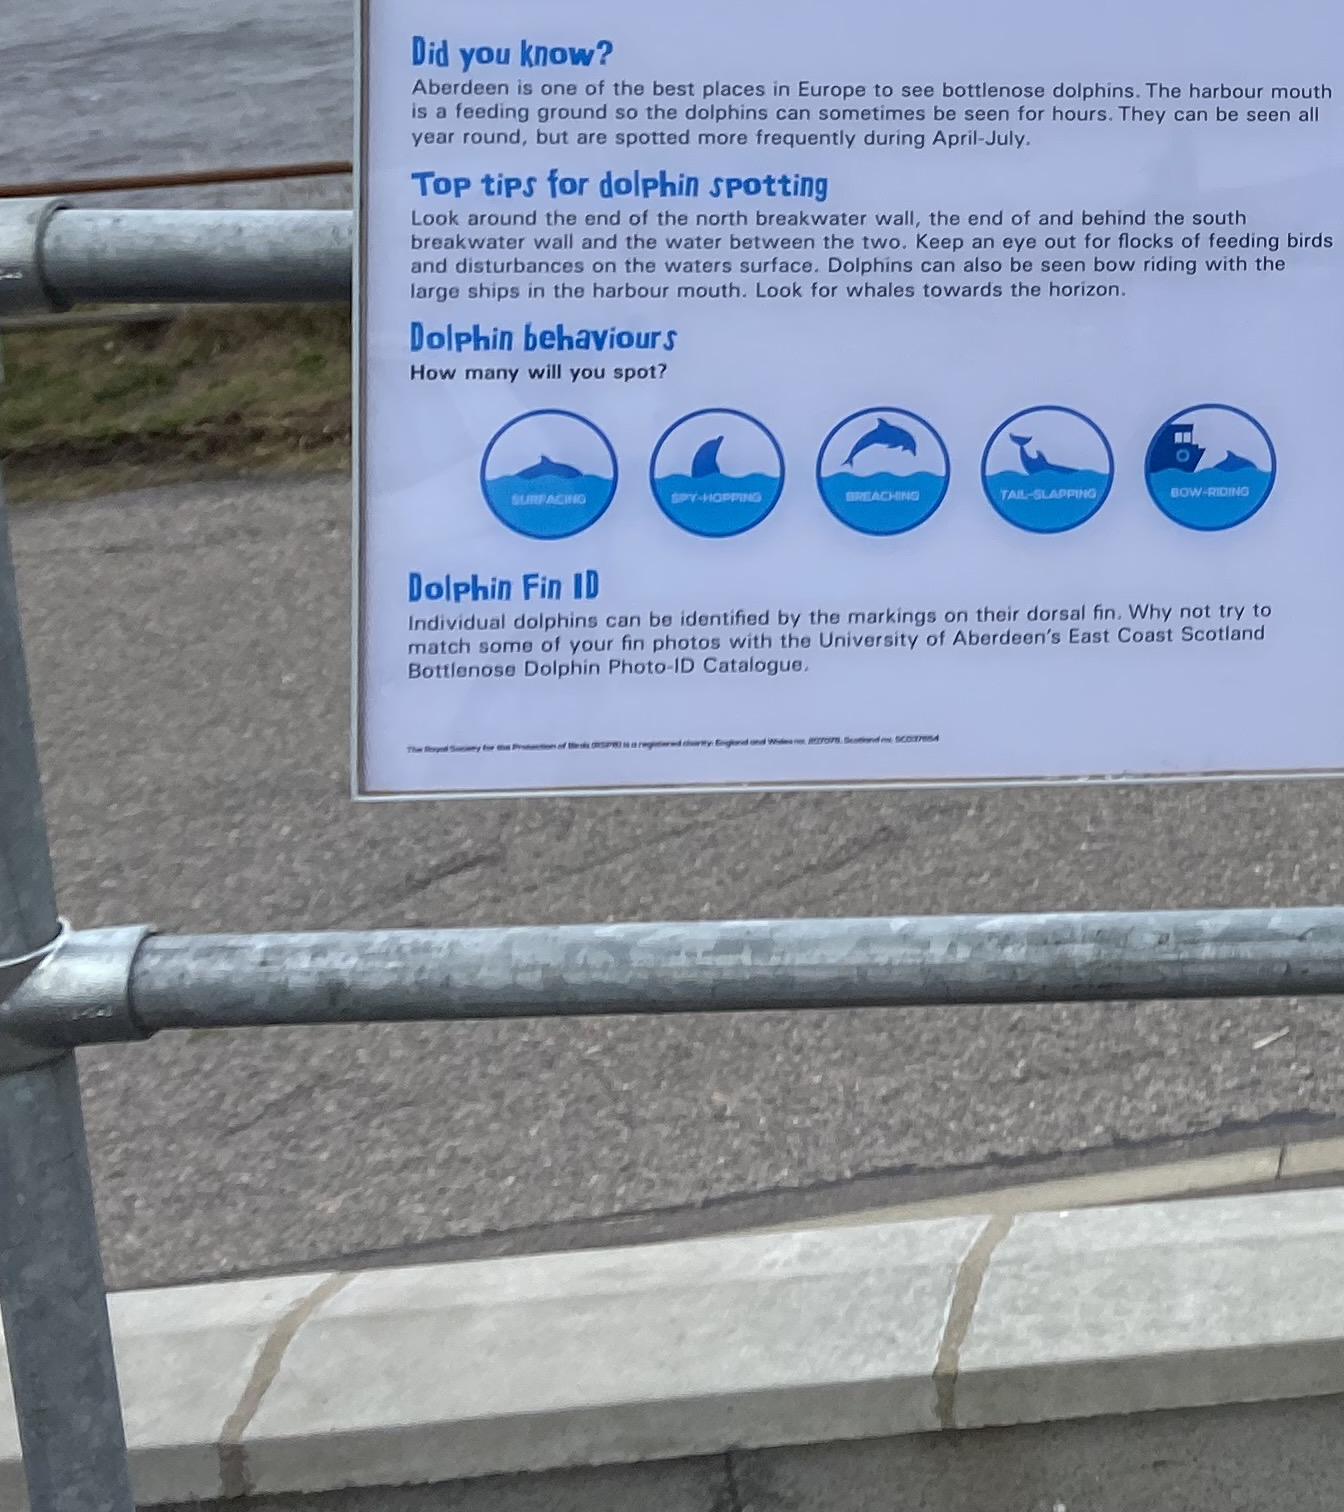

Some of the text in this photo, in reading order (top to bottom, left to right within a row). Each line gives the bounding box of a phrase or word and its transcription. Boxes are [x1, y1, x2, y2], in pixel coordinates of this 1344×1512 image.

[412, 36, 613, 73] Did you know?
[412, 79, 1331, 101] Aberdeen is one of the best places in Europe to see bottlenose dolphins. The harbour mouth
[412, 129, 1030, 149] year round, but are spotted more frequently during April-July.
[411, 168, 827, 202] Top tips for dolphin spotting
[411, 281, 1125, 302] large ships in the harbour mouth. Look for whales towards the horizon.
[411, 322, 677, 352] Dolphin behaviours
[411, 363, 667, 383] How many will you spot?
[511, 493, 586, 506] SURFACING
[845, 490, 920, 502] BREACHING
[1001, 488, 1096, 501] TAIL-SLAPPING
[1170, 486, 1249, 498] BOW-RIDING
[409, 570, 598, 603] Dolphin Fin ID
[409, 656, 808, 679] Bottlenose Dolphin Photo-ID Catalogue.
